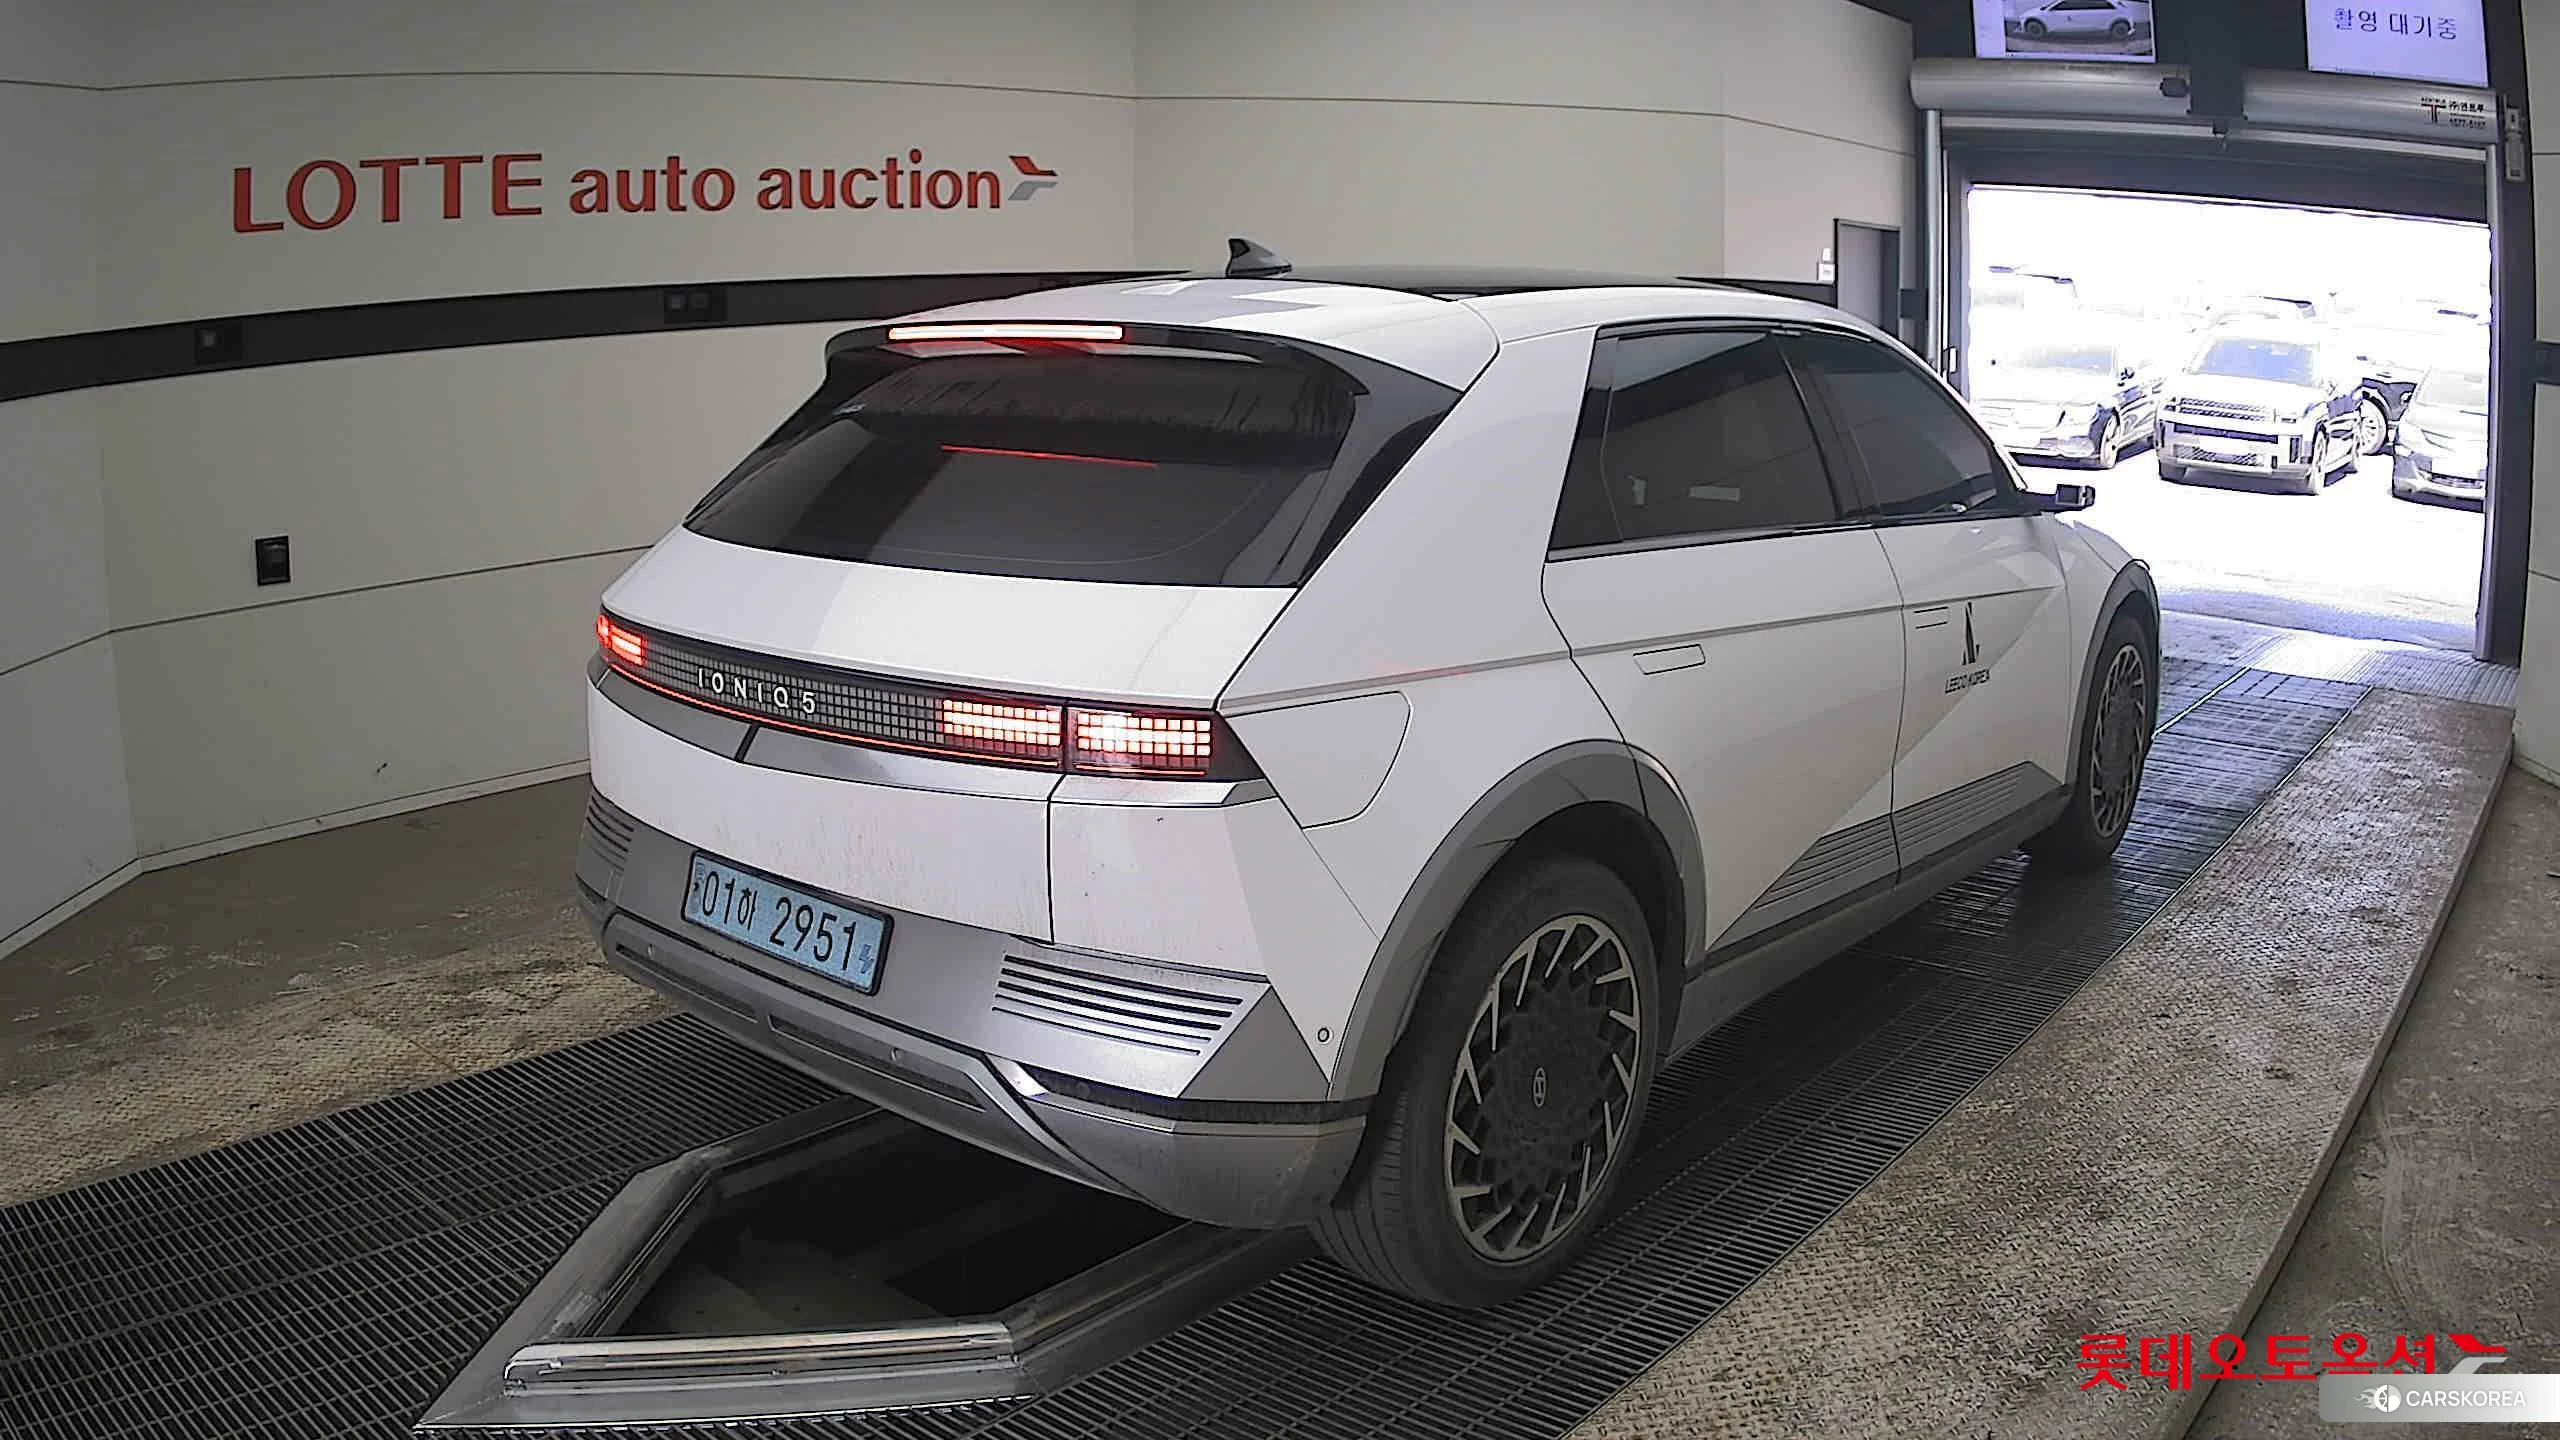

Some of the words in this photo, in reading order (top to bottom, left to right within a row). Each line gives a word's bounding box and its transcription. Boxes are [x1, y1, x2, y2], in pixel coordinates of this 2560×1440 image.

[2335, 7, 2377, 33] 촬영
[2389, 13, 2457, 40] 대기중
[235, 154, 541, 232] LOTTE
[571, 157, 736, 213] auto
[757, 150, 1001, 210] auction
[698, 668, 789, 709] IONIQ
[802, 691, 816, 714] 5
[702, 871, 758, 931] 01하
[769, 896, 857, 971] 2951
